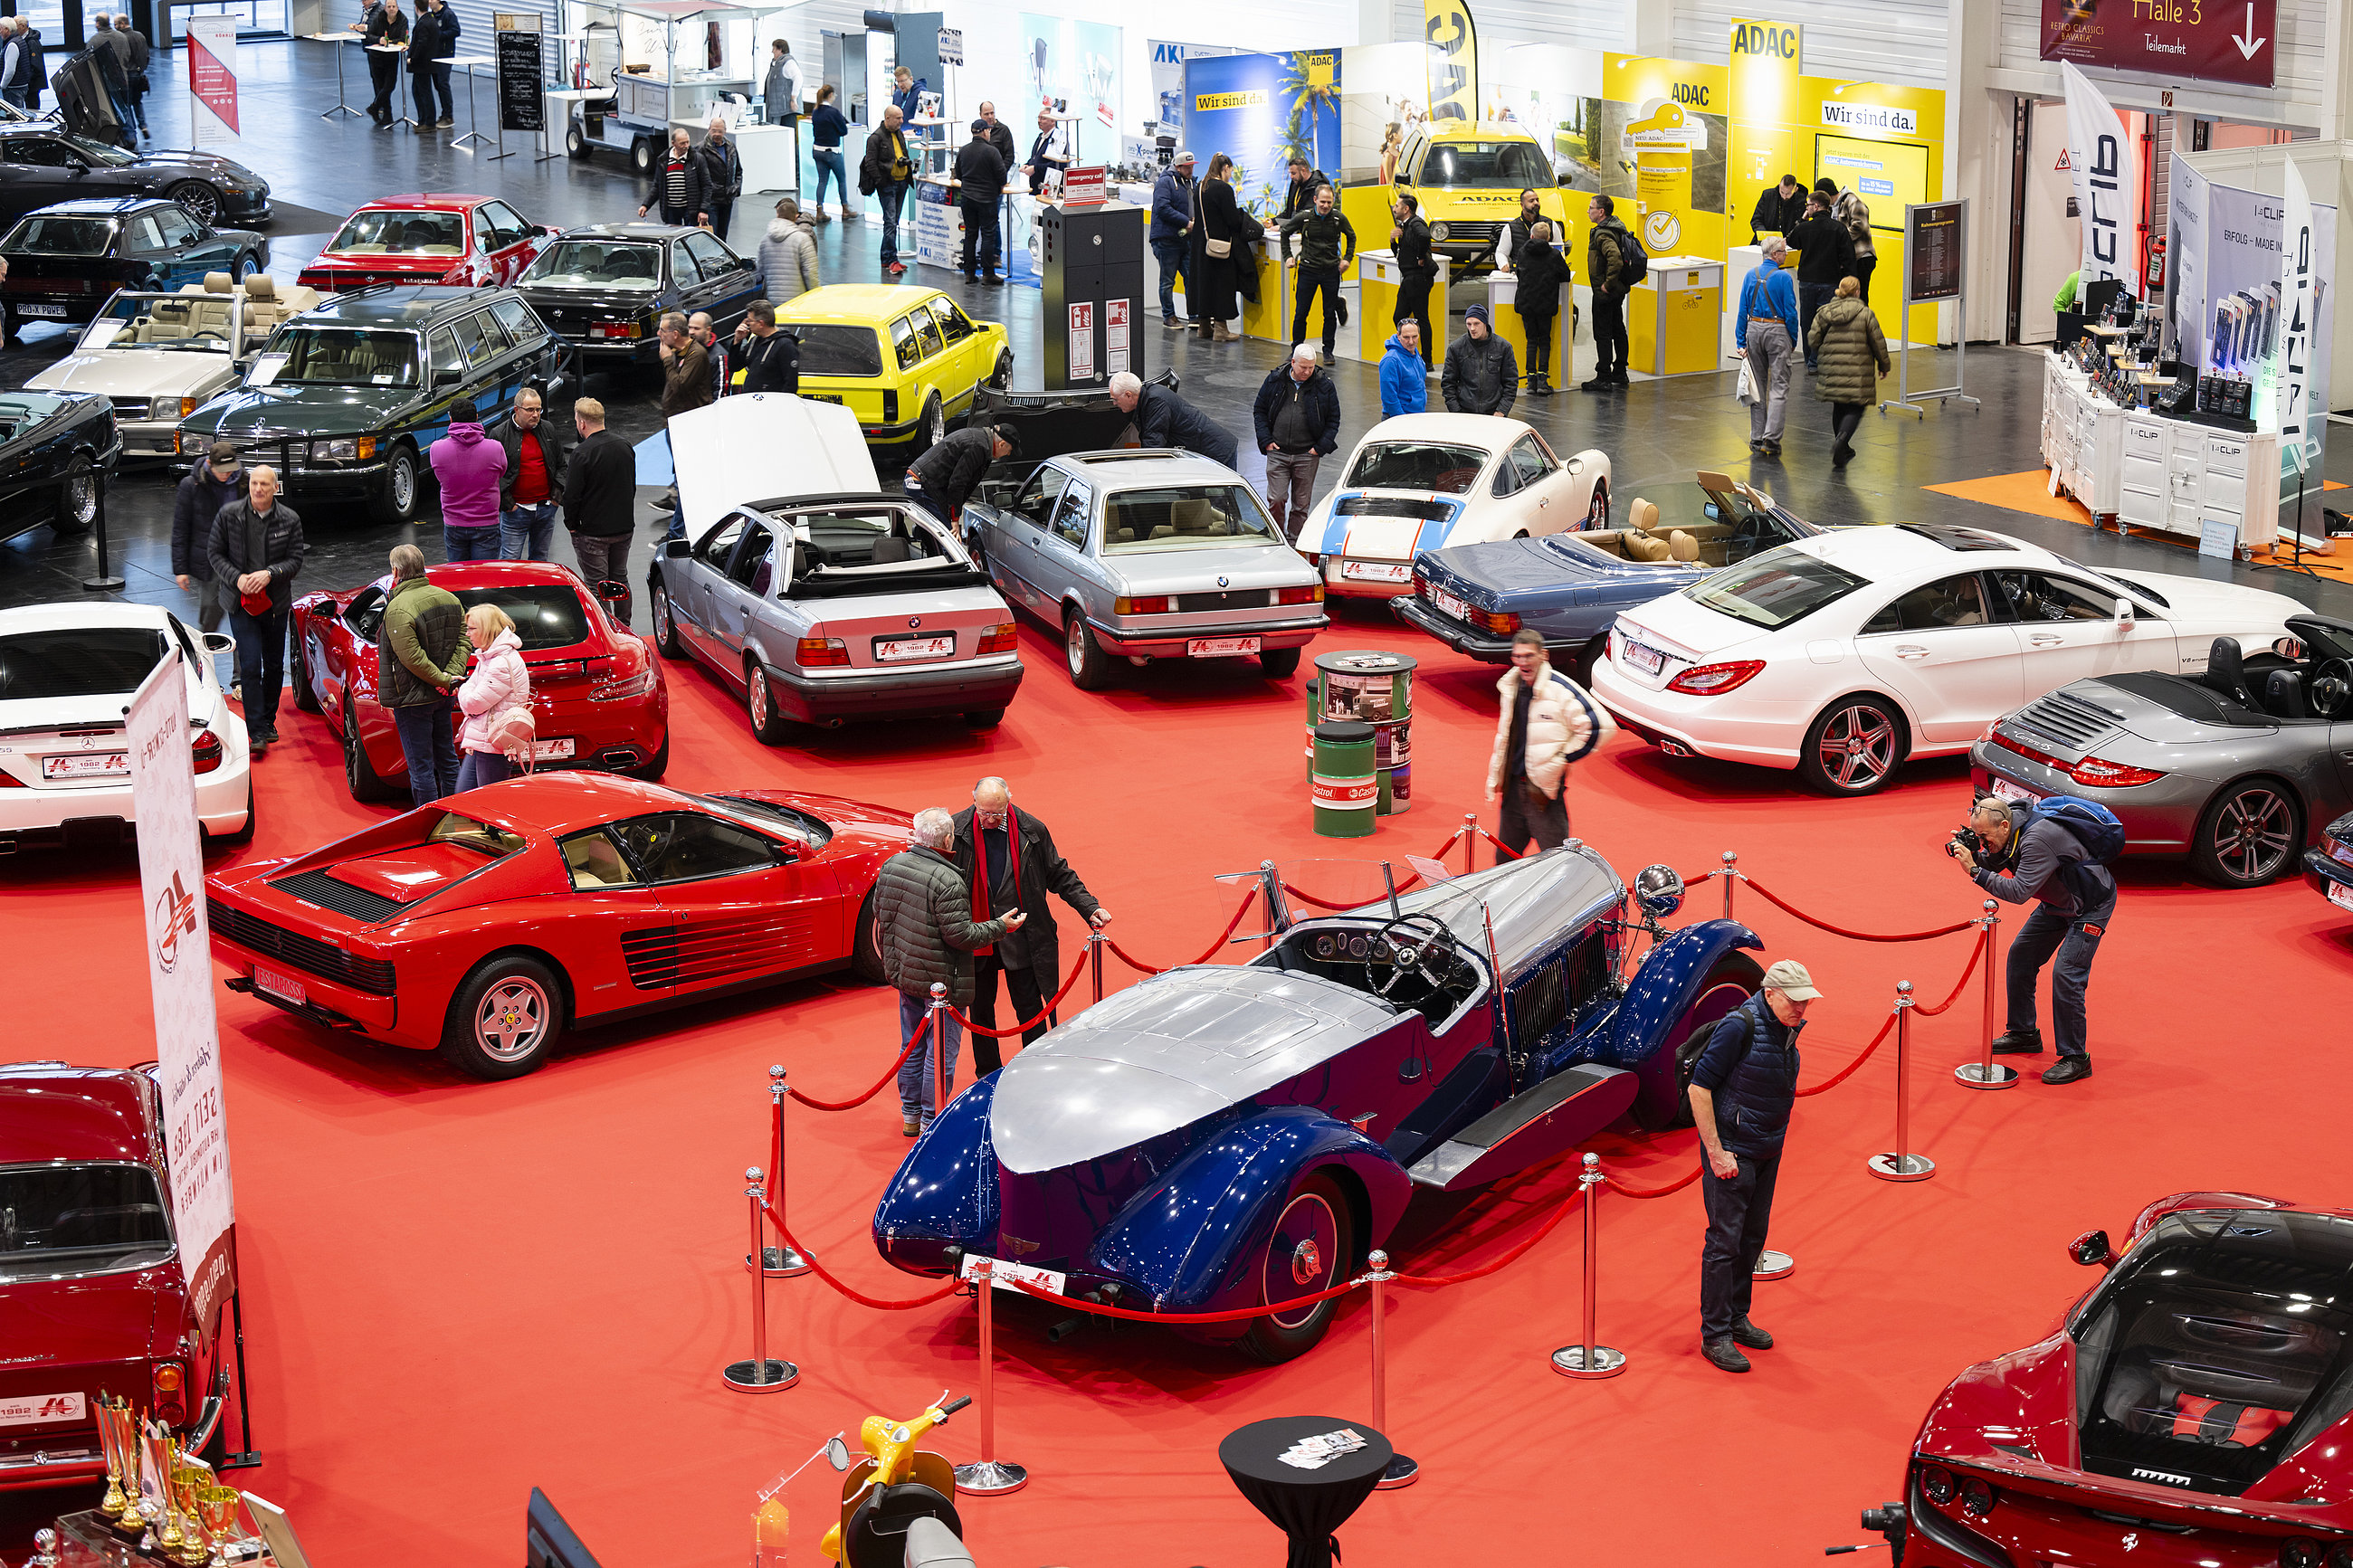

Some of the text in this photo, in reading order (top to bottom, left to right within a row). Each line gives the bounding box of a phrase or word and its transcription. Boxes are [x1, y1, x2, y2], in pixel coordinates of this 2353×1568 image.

[2188, 0, 2201, 24] 3
[2051, 22, 2104, 34] RETRO CLASSICS
[1734, 24, 1795, 58] ADAC
[2145, 33, 2186, 54] Teilemarkt
[1155, 44, 1184, 63] AKI
[1311, 56, 1332, 66] ADAC
[1198, 93, 1266, 109] Wir sind da.
[1672, 83, 1709, 106] ADAC
[1824, 106, 1913, 129] Wir sind da.
[1920, 220, 1955, 228] Rahmenprogramm
[2224, 230, 2248, 244] ERFOLG
[2254, 237, 2274, 251] MADE
[2276, 241, 2282, 252] IN
[919, 246, 931, 258] AKI
[43, 306, 65, 315] POWER
[2263, 366, 2272, 375] DIE
[1376, 728, 1391, 746] strol
[2015, 731, 2053, 751] Carrera 4S
[255, 966, 306, 1003] TESTAROSSA
